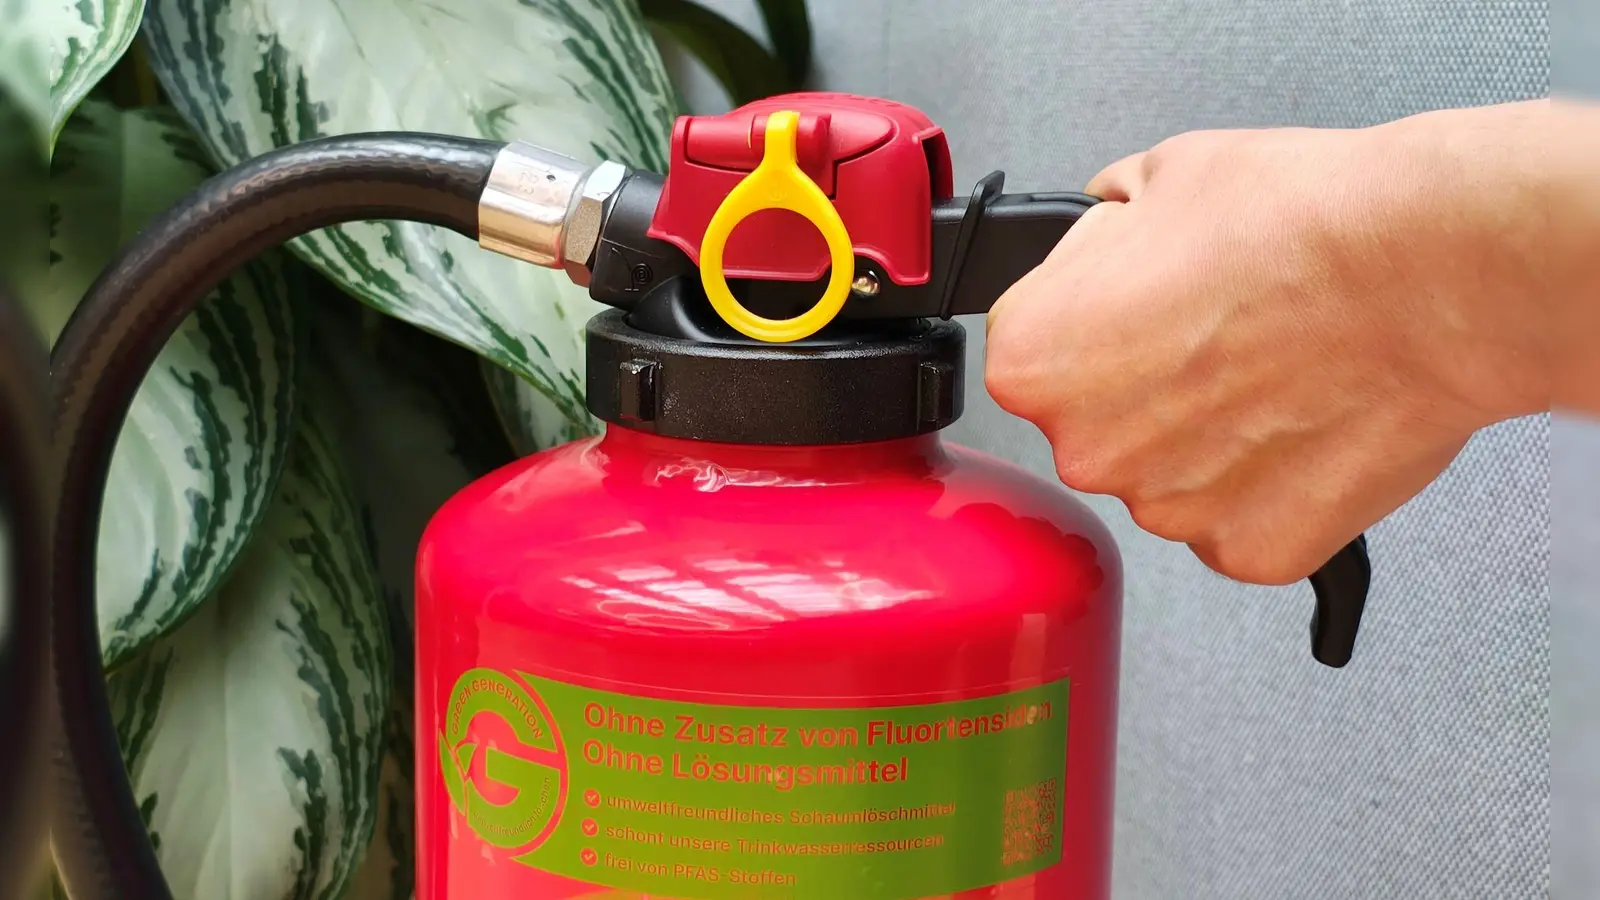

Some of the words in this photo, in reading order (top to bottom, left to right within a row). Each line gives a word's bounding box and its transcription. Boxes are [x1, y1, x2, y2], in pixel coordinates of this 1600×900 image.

[584, 702, 665, 738] Ohne
[674, 715, 787, 747] Zusatz
[799, 727, 858, 747] von
[867, 702, 1051, 745] Fluortensiden
[582, 740, 663, 776] Ohne
[672, 753, 907, 791] Lösungsmittel
[606, 796, 783, 824] umweltfreundliches
[789, 802, 955, 824] Schaumlöschmittel
[606, 825, 665, 846] schont
[669, 834, 731, 852] unsere
[737, 835, 943, 855] Trinkwasserressourcen
[605, 852, 633, 870] frei
[637, 861, 669, 877] von
[673, 863, 796, 885] PFAS-Stoffen
